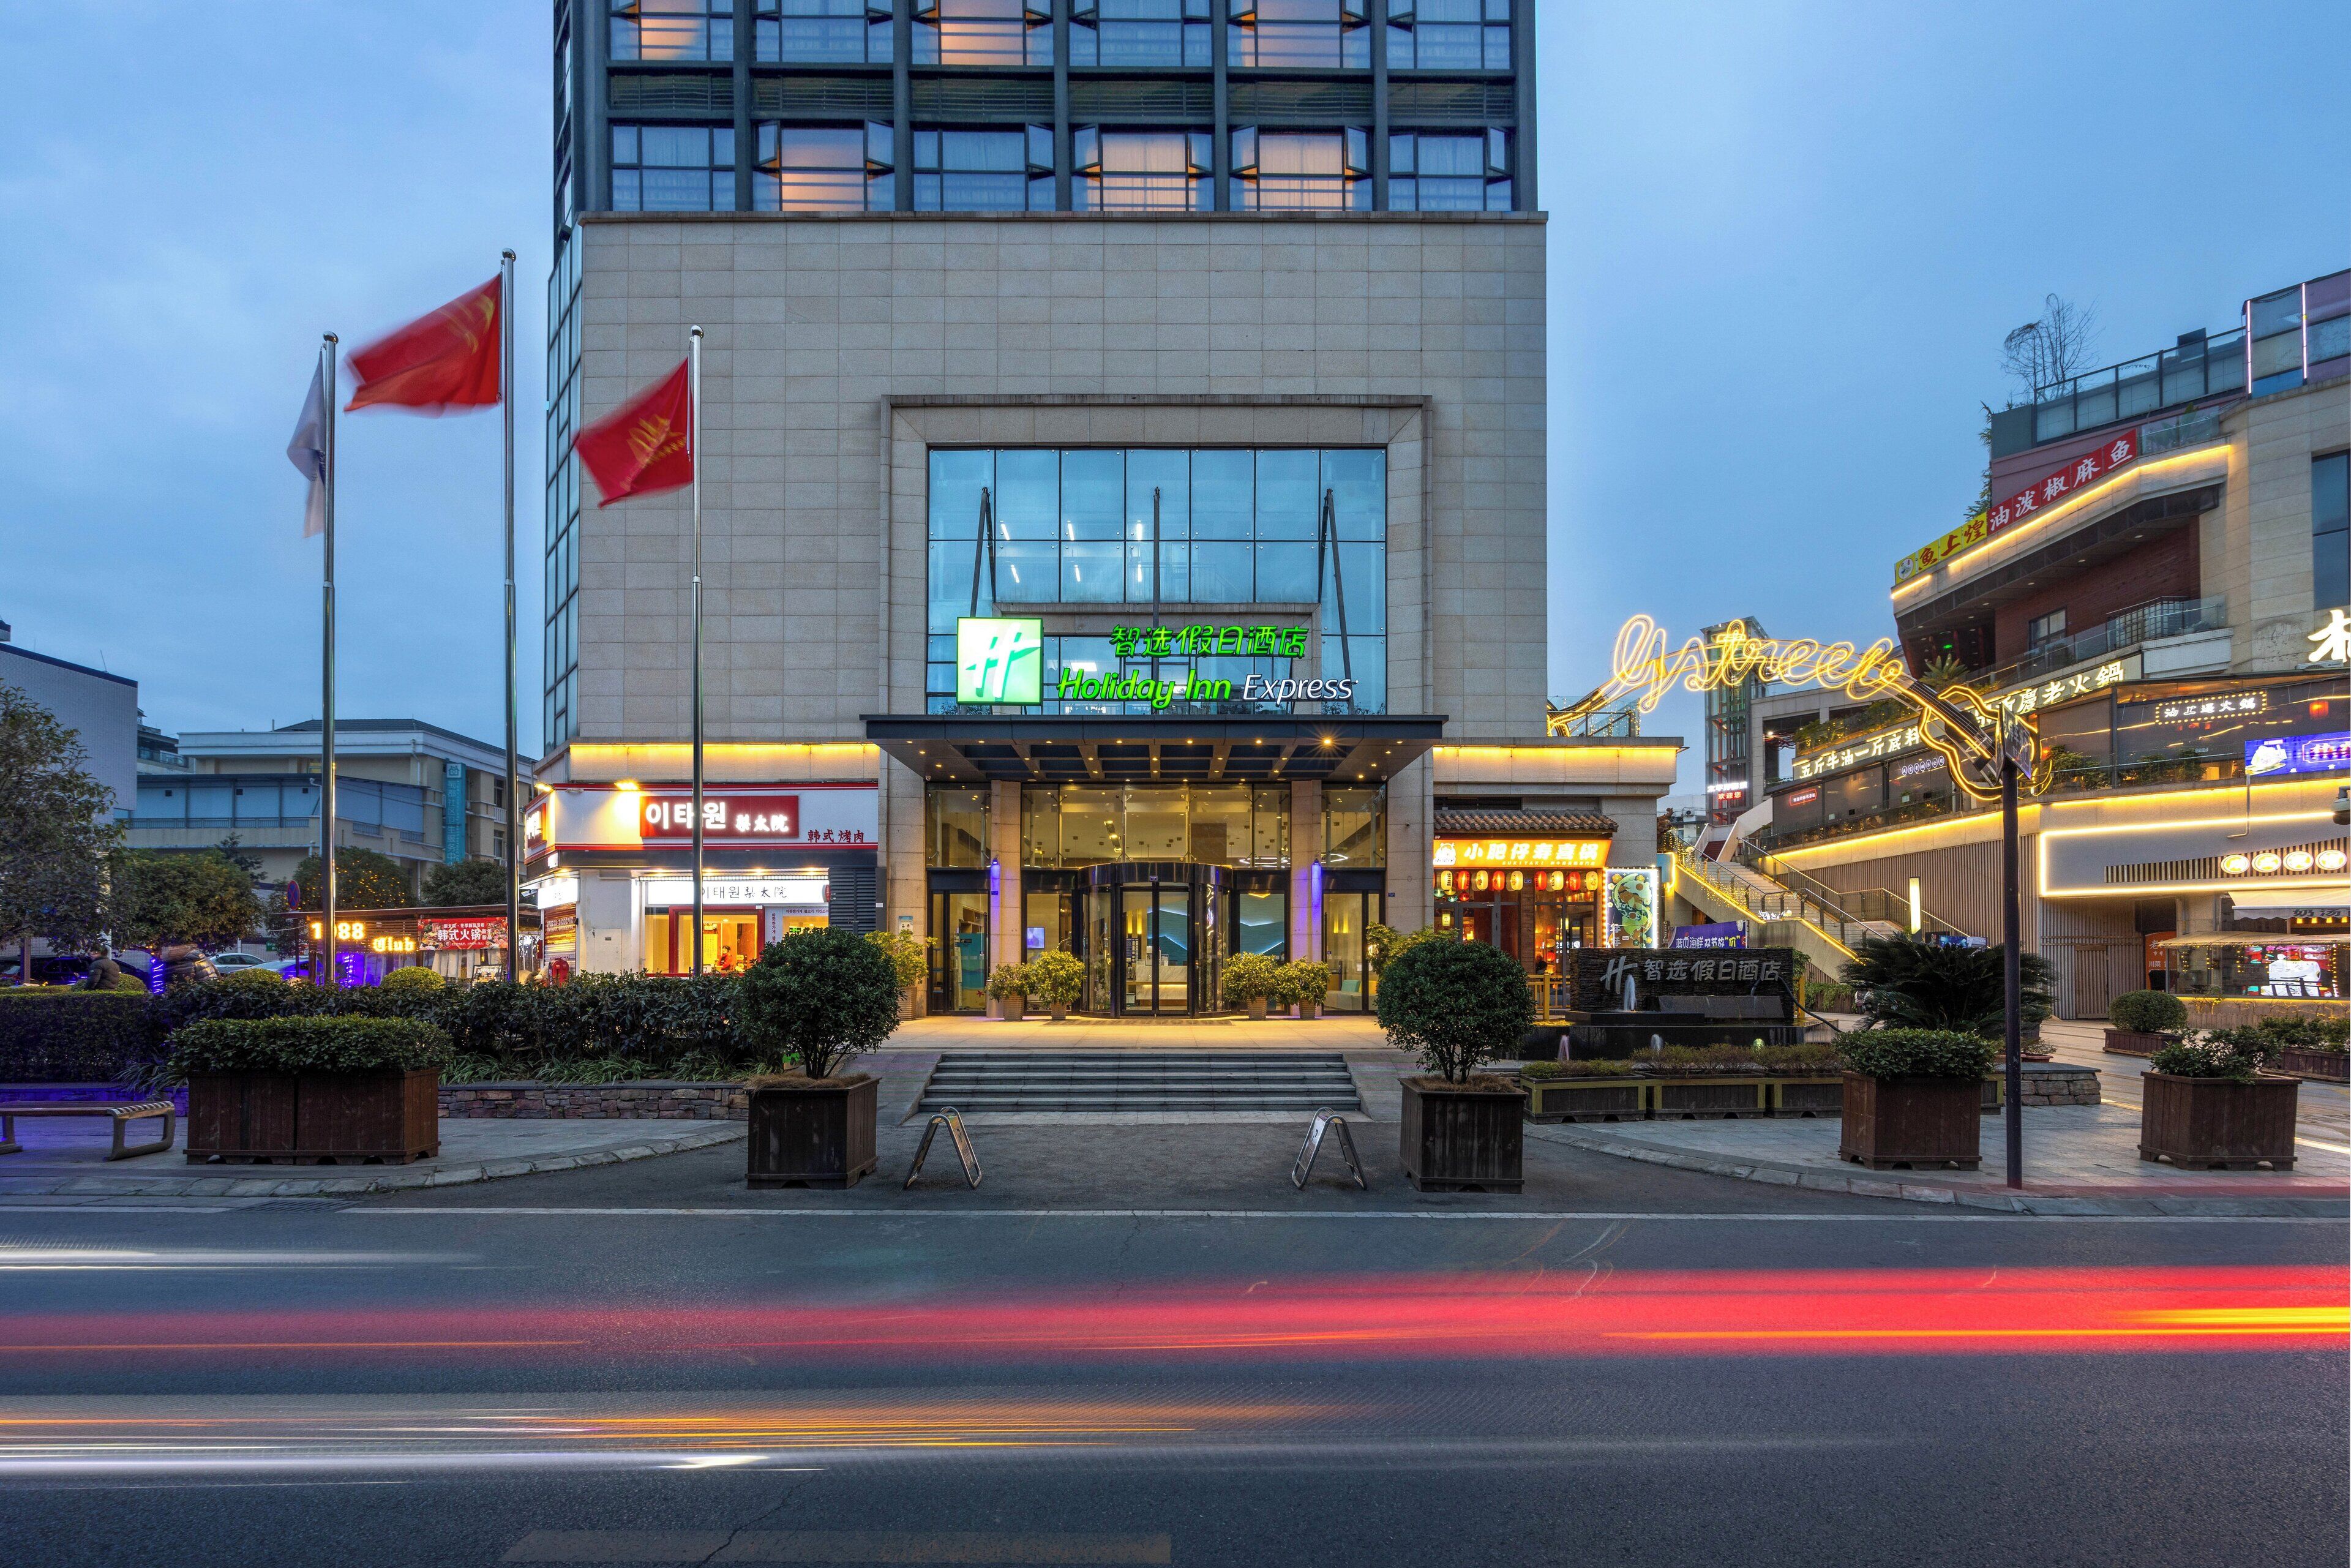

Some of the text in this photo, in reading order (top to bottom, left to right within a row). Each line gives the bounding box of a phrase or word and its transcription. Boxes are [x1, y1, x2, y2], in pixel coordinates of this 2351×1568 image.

[1111, 624, 1309, 659] 智选假日酒店
[1057, 668, 1354, 710] Holiday Inn Express
[1799, 726, 1920, 779] 五斤牛油一斤底料
[808, 829, 864, 843] 韩式烤肉
[2292, 909, 2351, 917] 奶汤
[310, 921, 364, 940] 188
[437, 929, 481, 941] 韩式火锅
[373, 936, 415, 952] Club
[1643, 958, 1782, 981] 智选假日酒店
